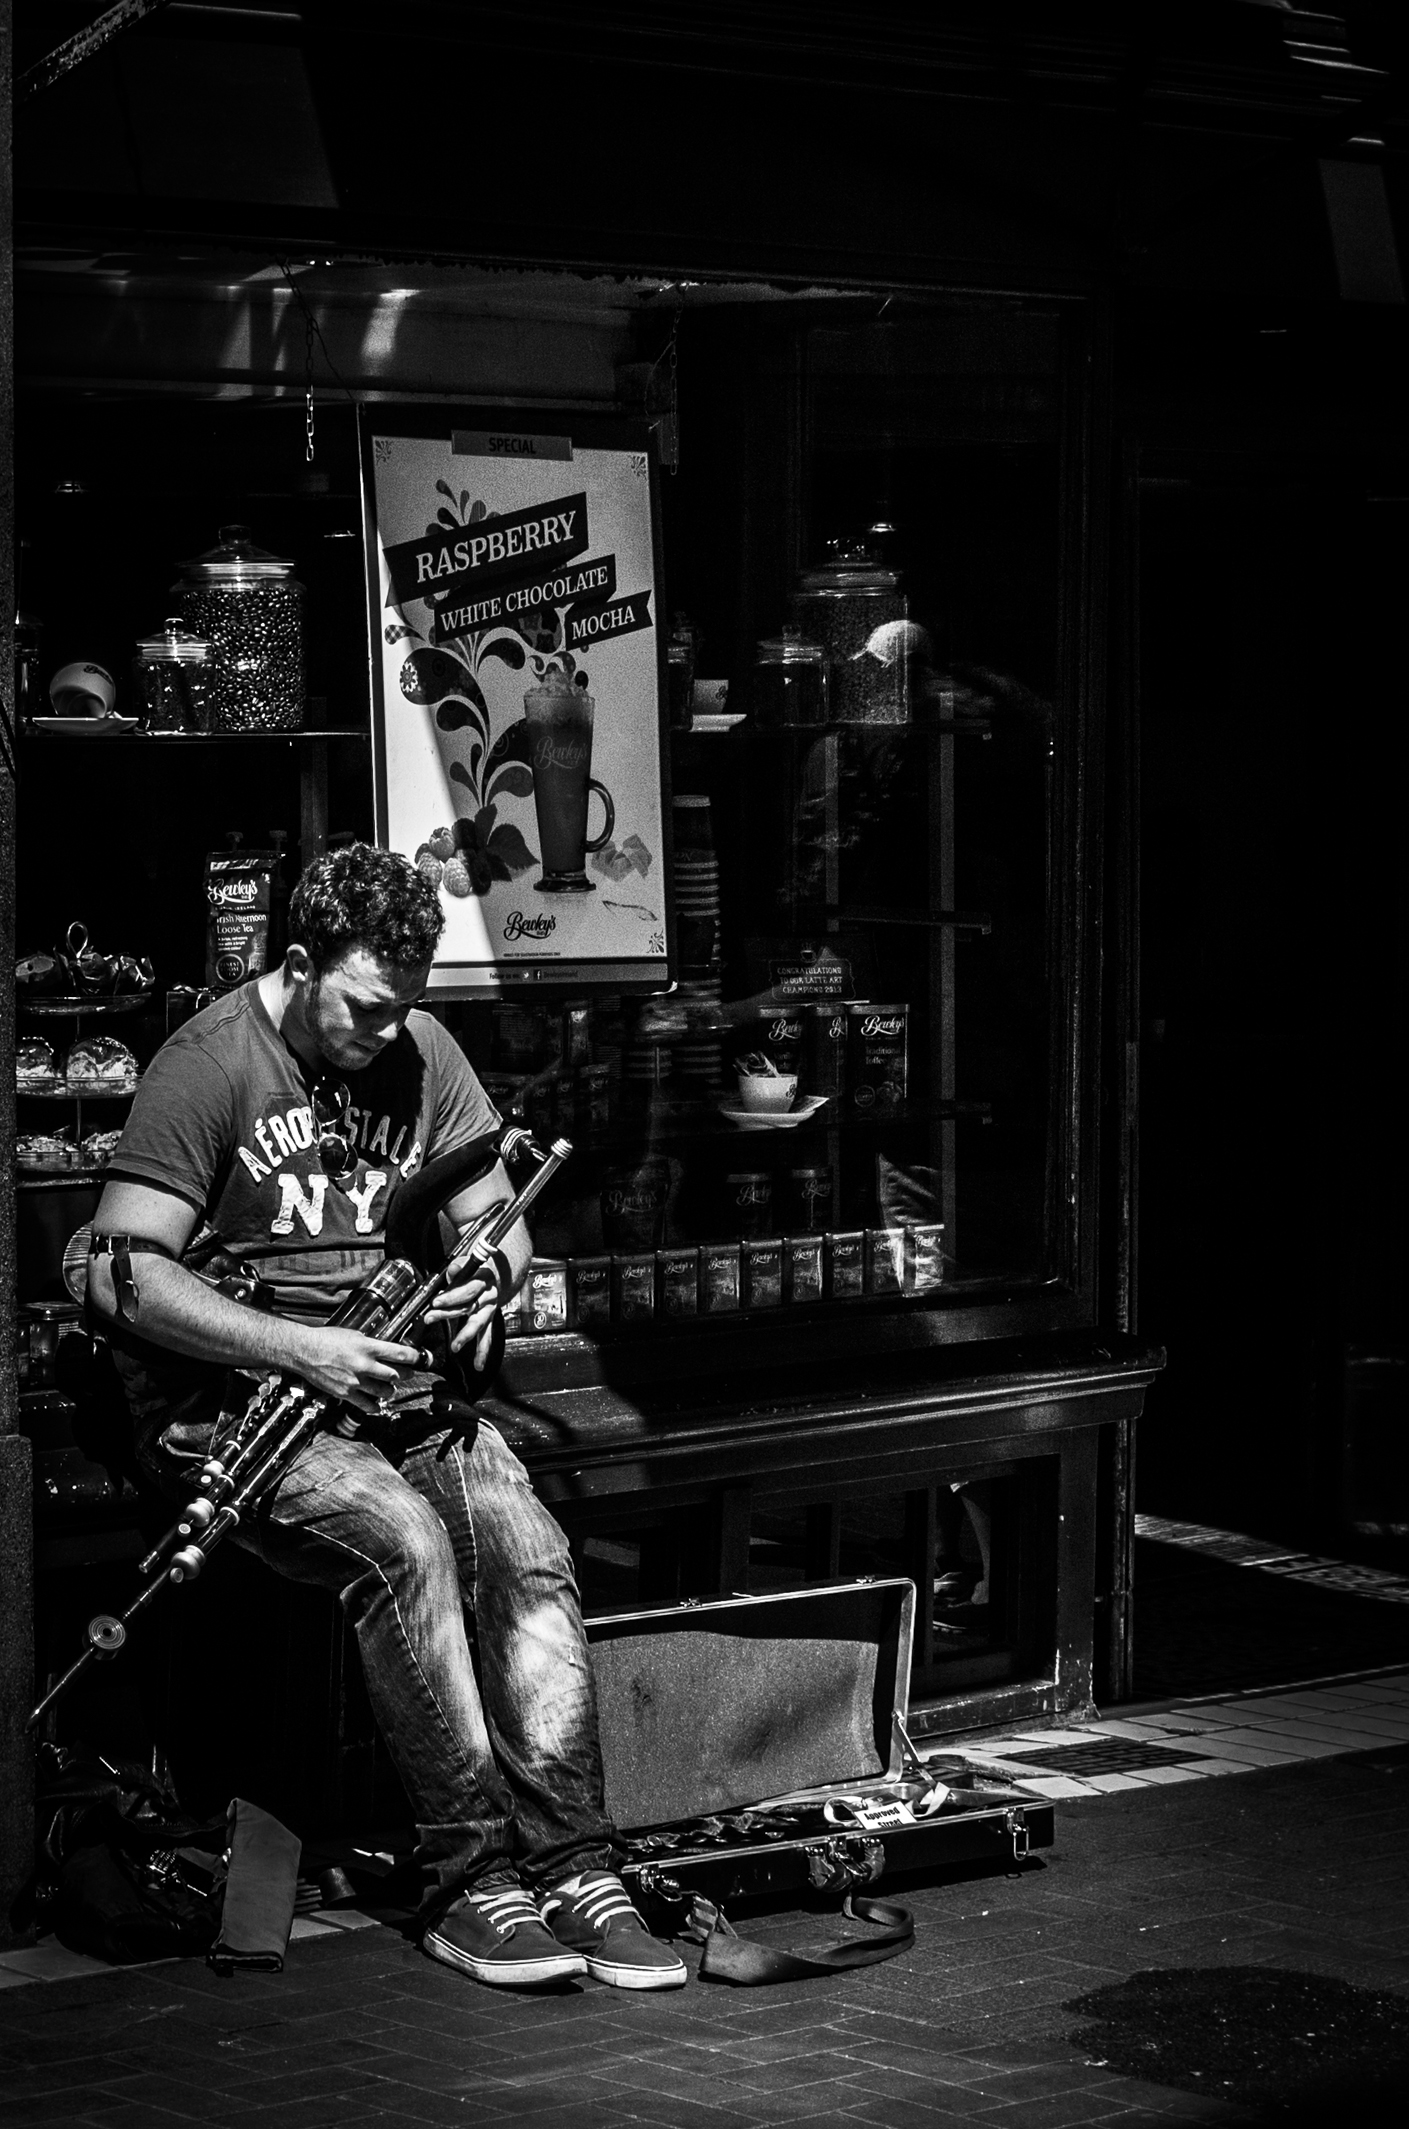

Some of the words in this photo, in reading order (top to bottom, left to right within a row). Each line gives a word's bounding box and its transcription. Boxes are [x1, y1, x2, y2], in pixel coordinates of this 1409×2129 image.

[488, 437, 536, 454] SPECIAL
[415, 510, 577, 584] RASPBERRY
[440, 604, 502, 632] WHITE
[505, 565, 609, 613] CHOCOLATE
[571, 605, 636, 641] MOCHA
[216, 924, 241, 935] Loose
[241, 923, 254, 933] Tea
[804, 976, 827, 985] LATTE
[829, 976, 842, 984] ART
[864, 1807, 900, 1820] Approved
